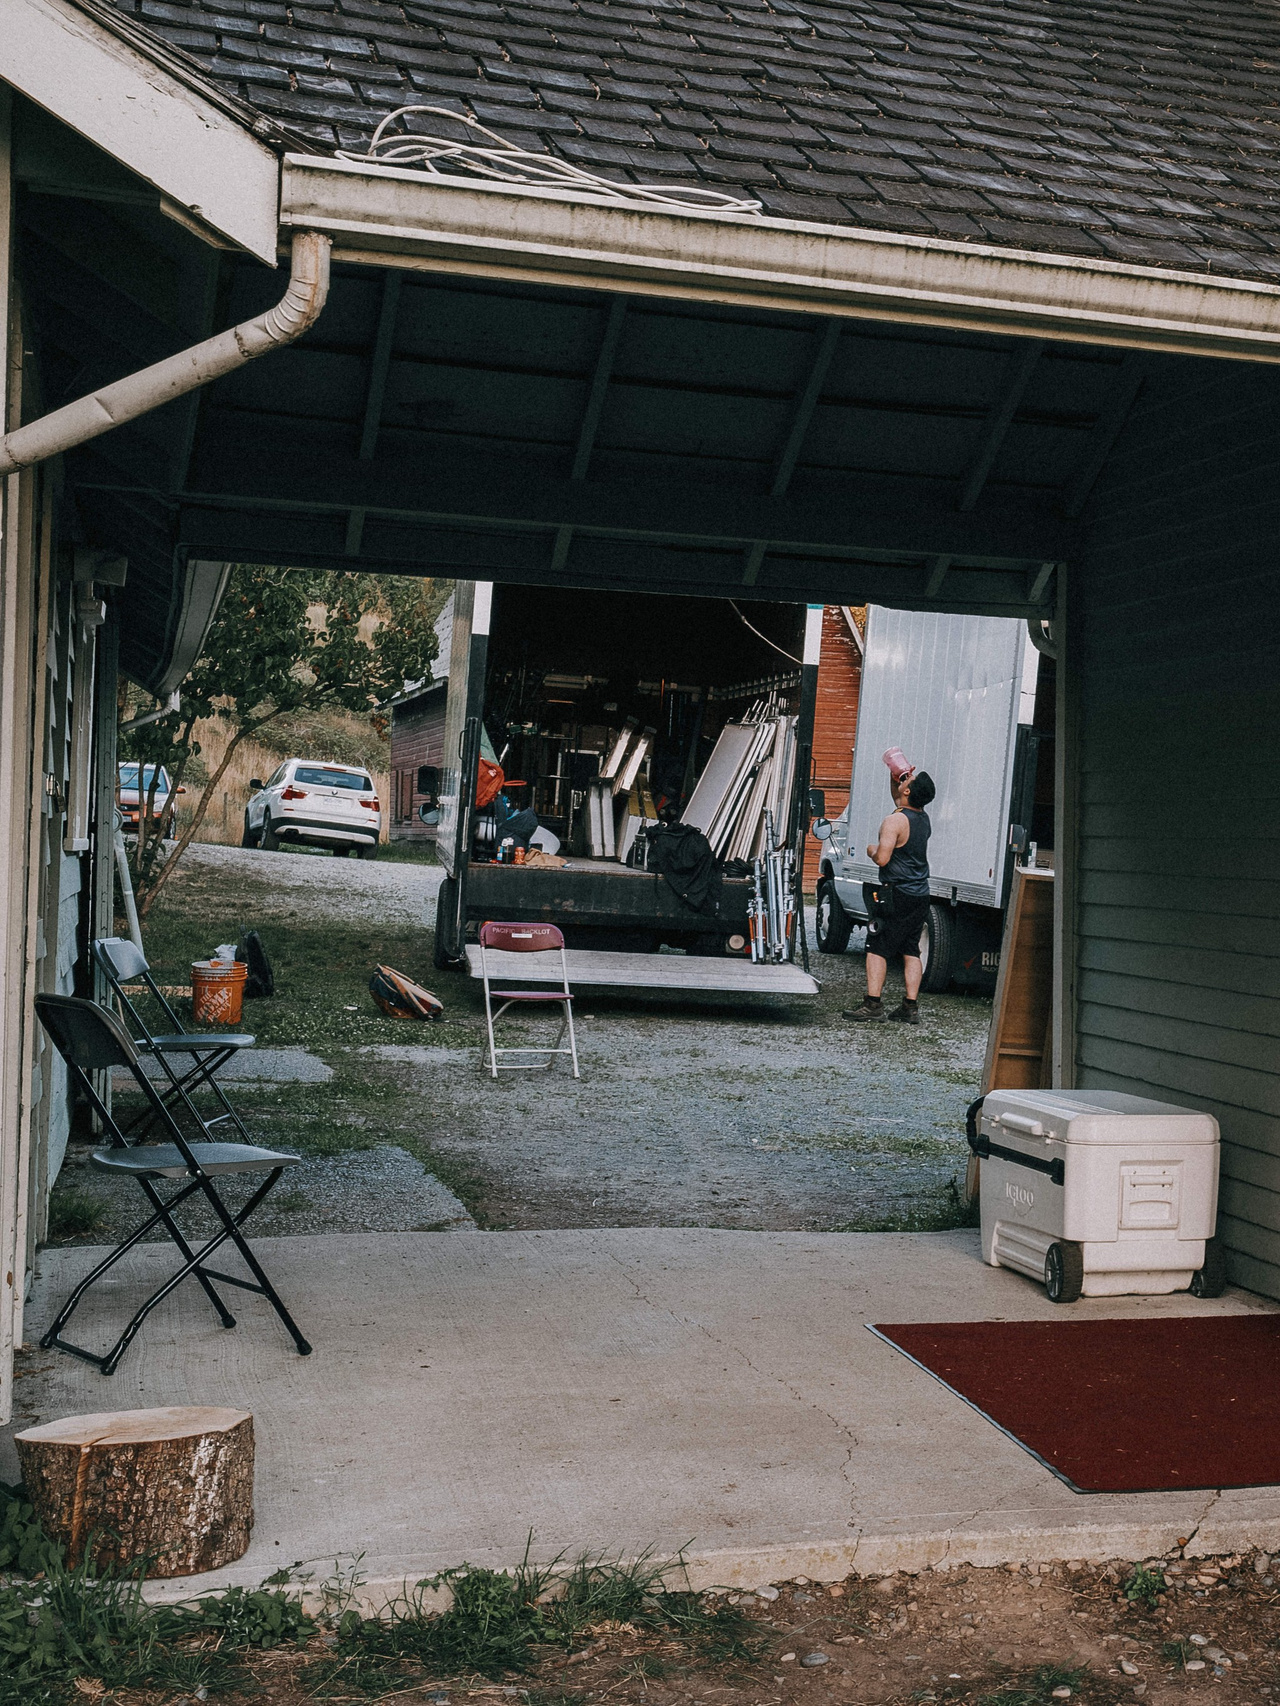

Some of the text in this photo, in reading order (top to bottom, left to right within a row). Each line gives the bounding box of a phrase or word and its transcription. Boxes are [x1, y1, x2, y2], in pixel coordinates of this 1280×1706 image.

[196, 987, 232, 1020] HOME
[200, 990, 214, 1004] THE
[207, 1000, 231, 1022] DEPOT
